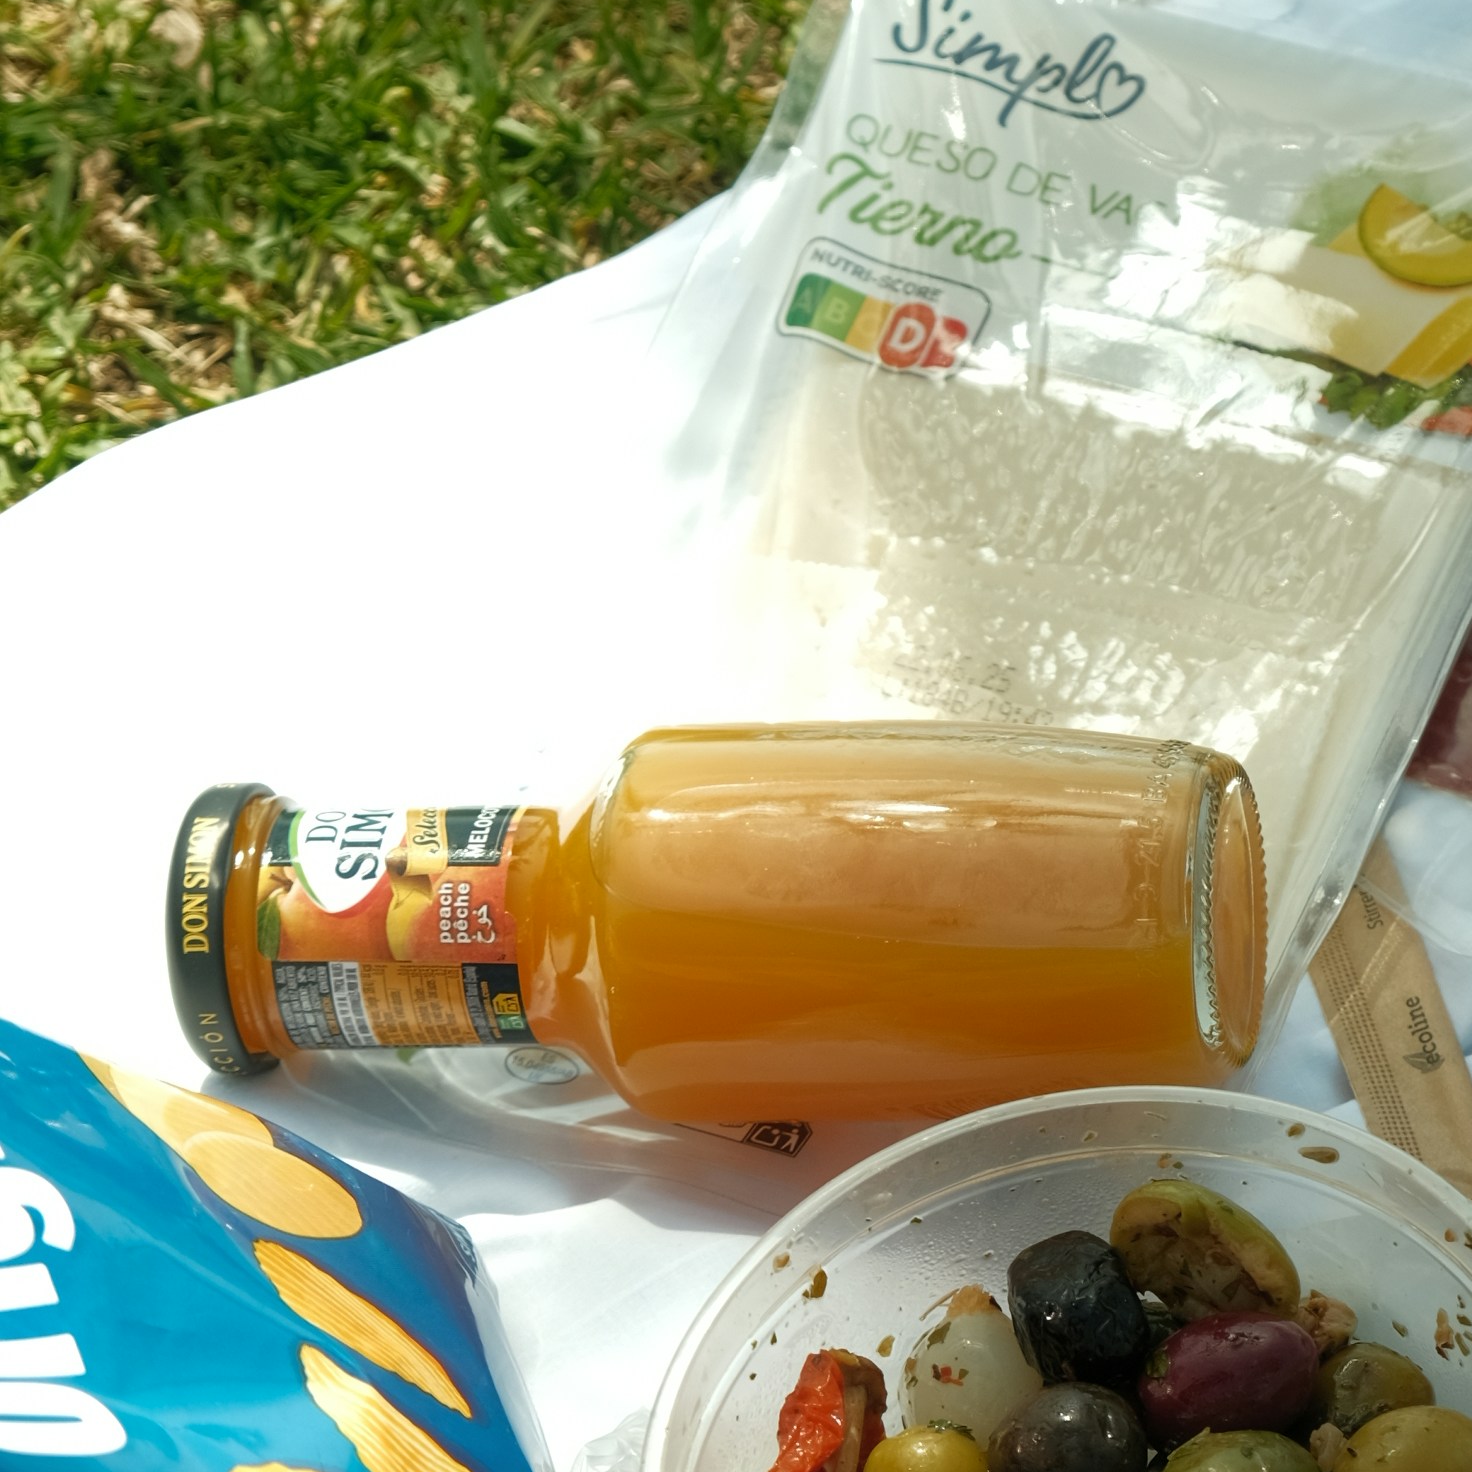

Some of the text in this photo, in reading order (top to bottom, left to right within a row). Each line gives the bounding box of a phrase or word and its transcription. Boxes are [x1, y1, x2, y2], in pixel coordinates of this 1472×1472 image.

[845, 113, 992, 182] QUESO
[1006, 161, 1070, 207] DE
[815, 154, 1019, 264] Tierno
[813, 249, 942, 305] NUTRI-SCORE
[823, 295, 851, 325] B
[886, 313, 928, 356] D
[180, 890, 211, 954] DON
[438, 882, 454, 943] peach
[453, 882, 471, 943] pêche
[471, 904, 495, 944] خوخ
[1406, 994, 1441, 1067] ecoline
